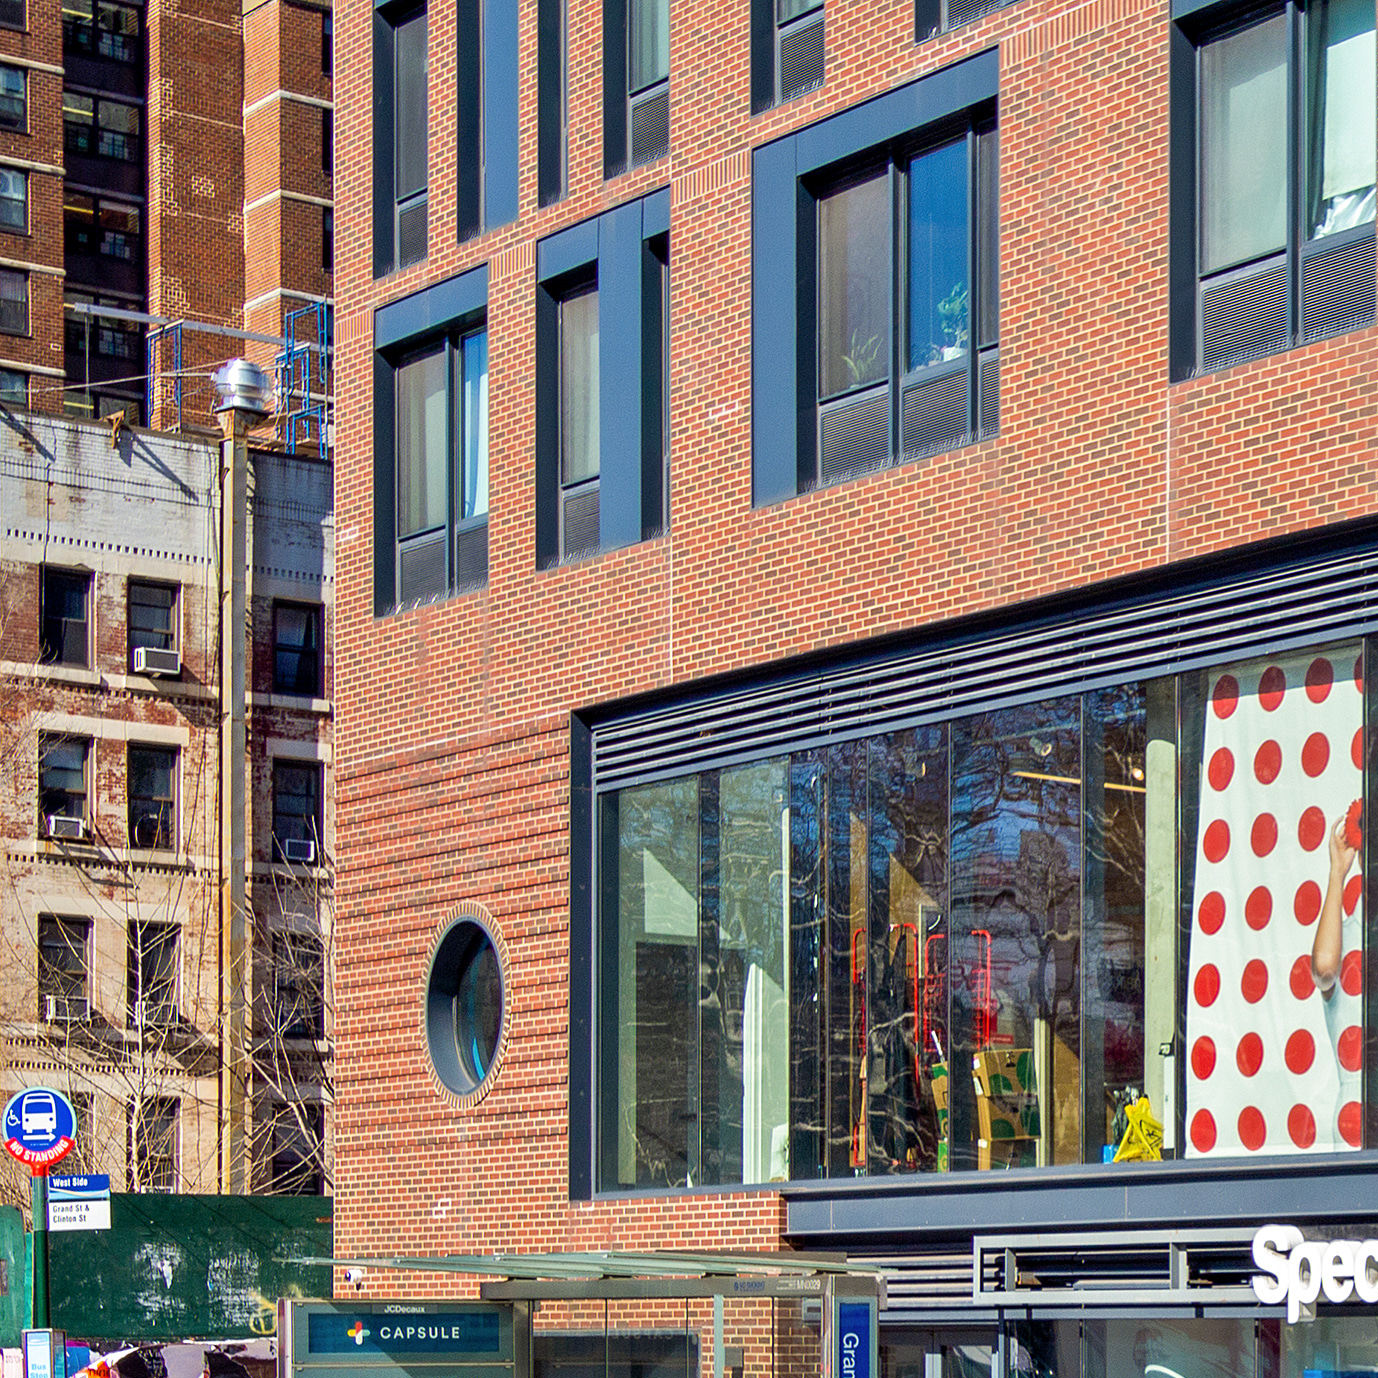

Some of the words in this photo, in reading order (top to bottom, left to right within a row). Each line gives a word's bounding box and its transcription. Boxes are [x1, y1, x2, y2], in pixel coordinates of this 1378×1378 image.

[10, 1140, 24, 1156] NO
[24, 1139, 69, 1162] STANDING
[53, 1178, 70, 1187] West
[72, 1177, 88, 1187] Side
[52, 1204, 73, 1212] Grand
[75, 1204, 83, 1212] St
[53, 1214, 77, 1223] Clinton
[79, 1214, 86, 1222] St
[384, 1304, 425, 1314] JCDecaux
[380, 1326, 461, 1340] CAPSULE
